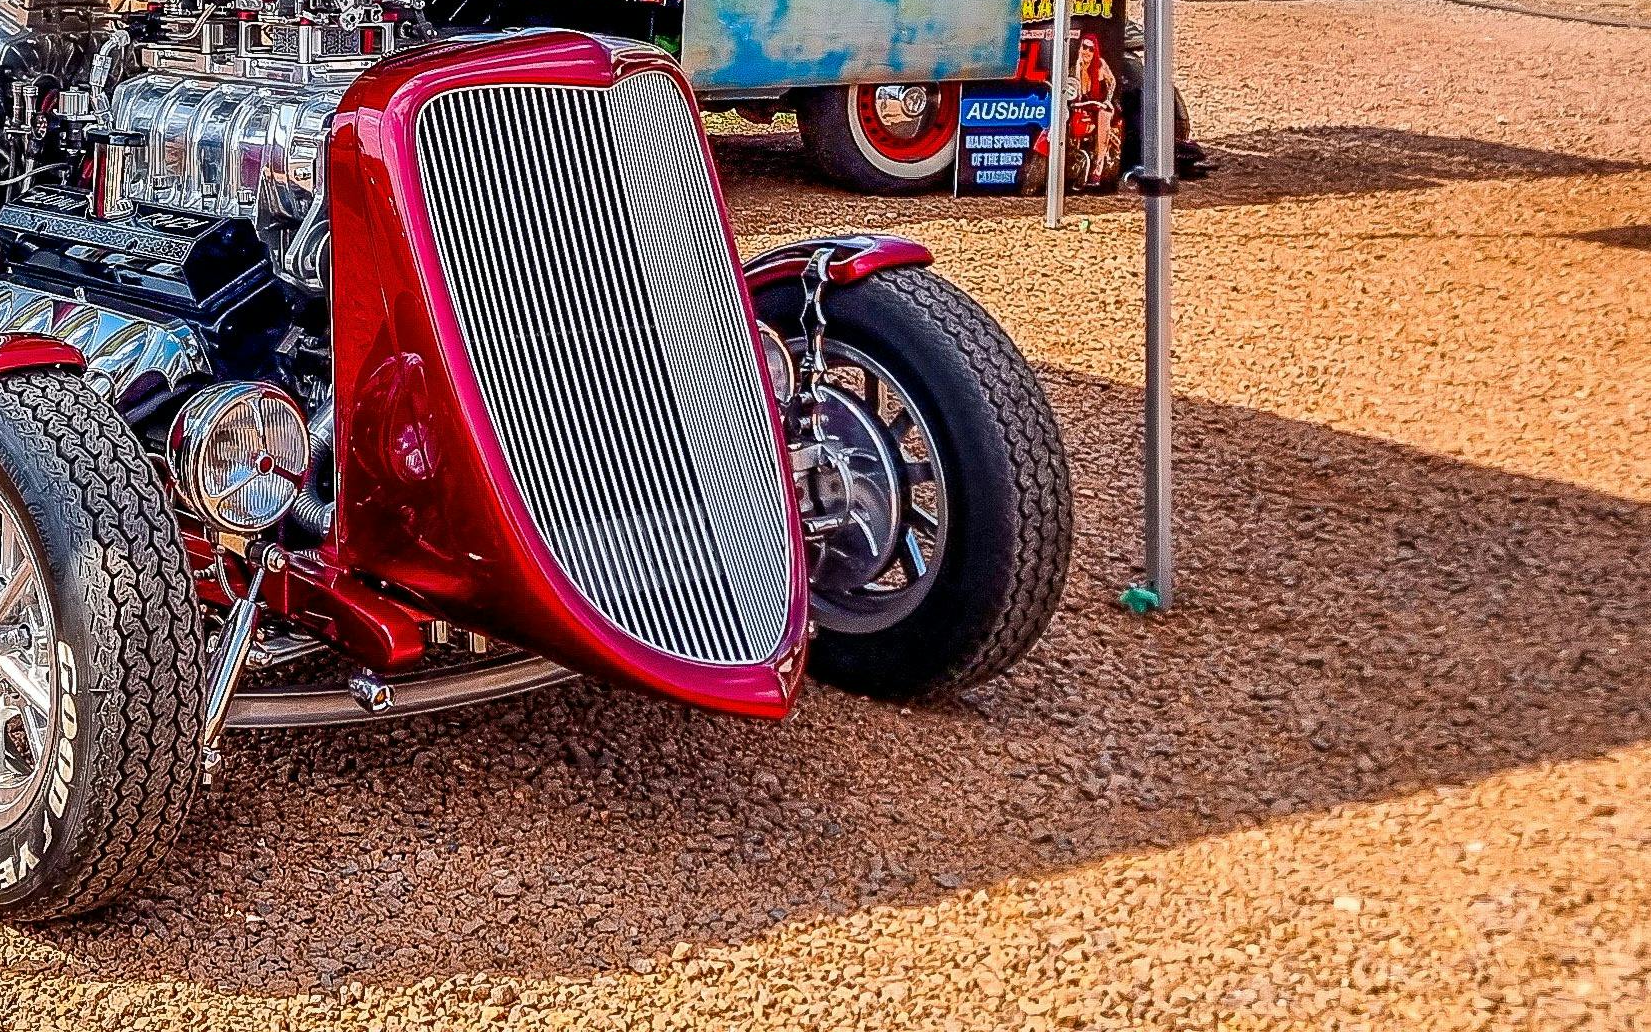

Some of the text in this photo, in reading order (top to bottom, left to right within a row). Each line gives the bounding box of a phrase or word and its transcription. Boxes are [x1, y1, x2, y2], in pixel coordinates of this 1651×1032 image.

[965, 101, 1046, 120] AUSblue
[993, 134, 1030, 149] SPONSOR
[971, 152, 983, 166] OF
[983, 152, 999, 166] THE
[47, 639, 78, 819] GOOD
